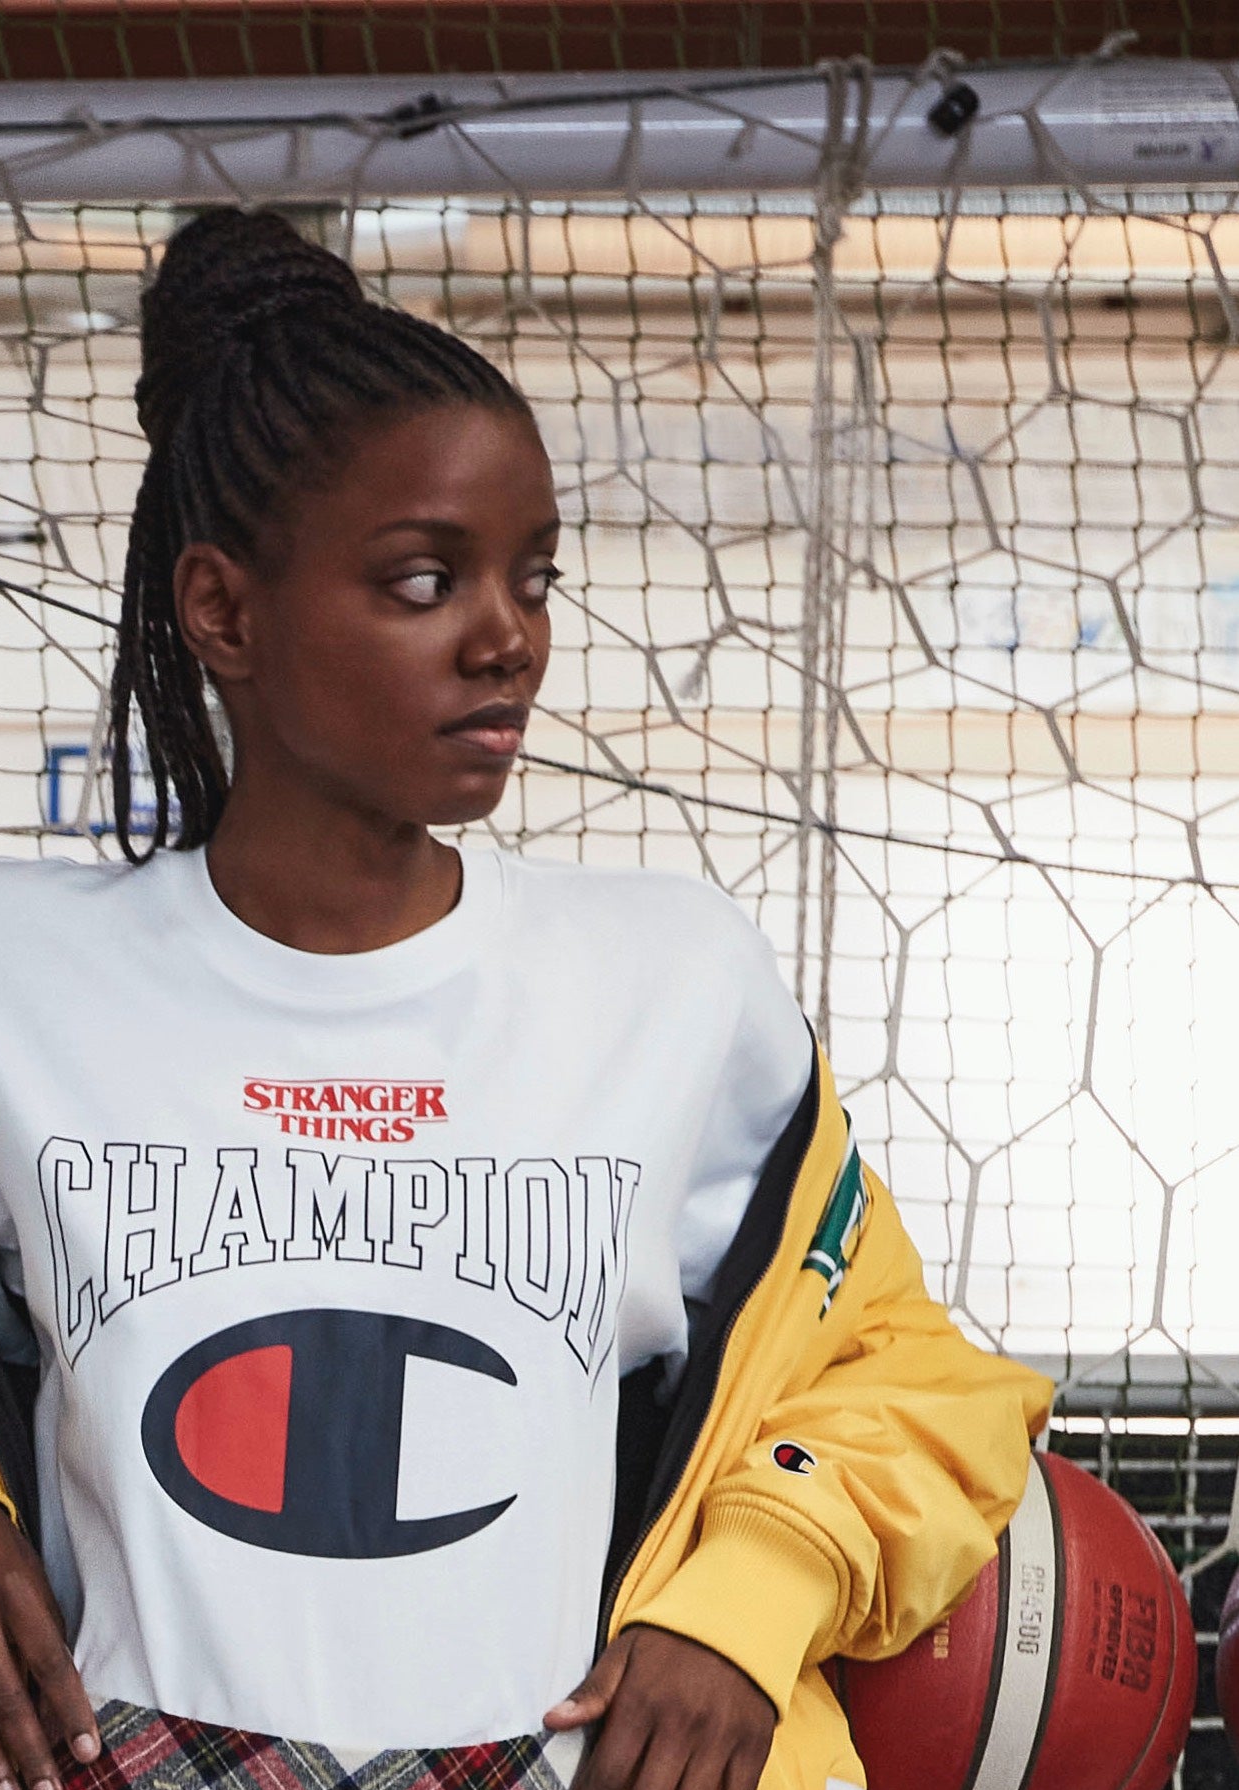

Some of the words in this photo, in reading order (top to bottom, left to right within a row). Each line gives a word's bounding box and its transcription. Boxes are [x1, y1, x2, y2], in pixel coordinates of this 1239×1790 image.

[243, 1079, 448, 1122] STRANGER
[275, 1113, 415, 1143] THINGS
[37, 1136, 642, 1402] CHAMPION
